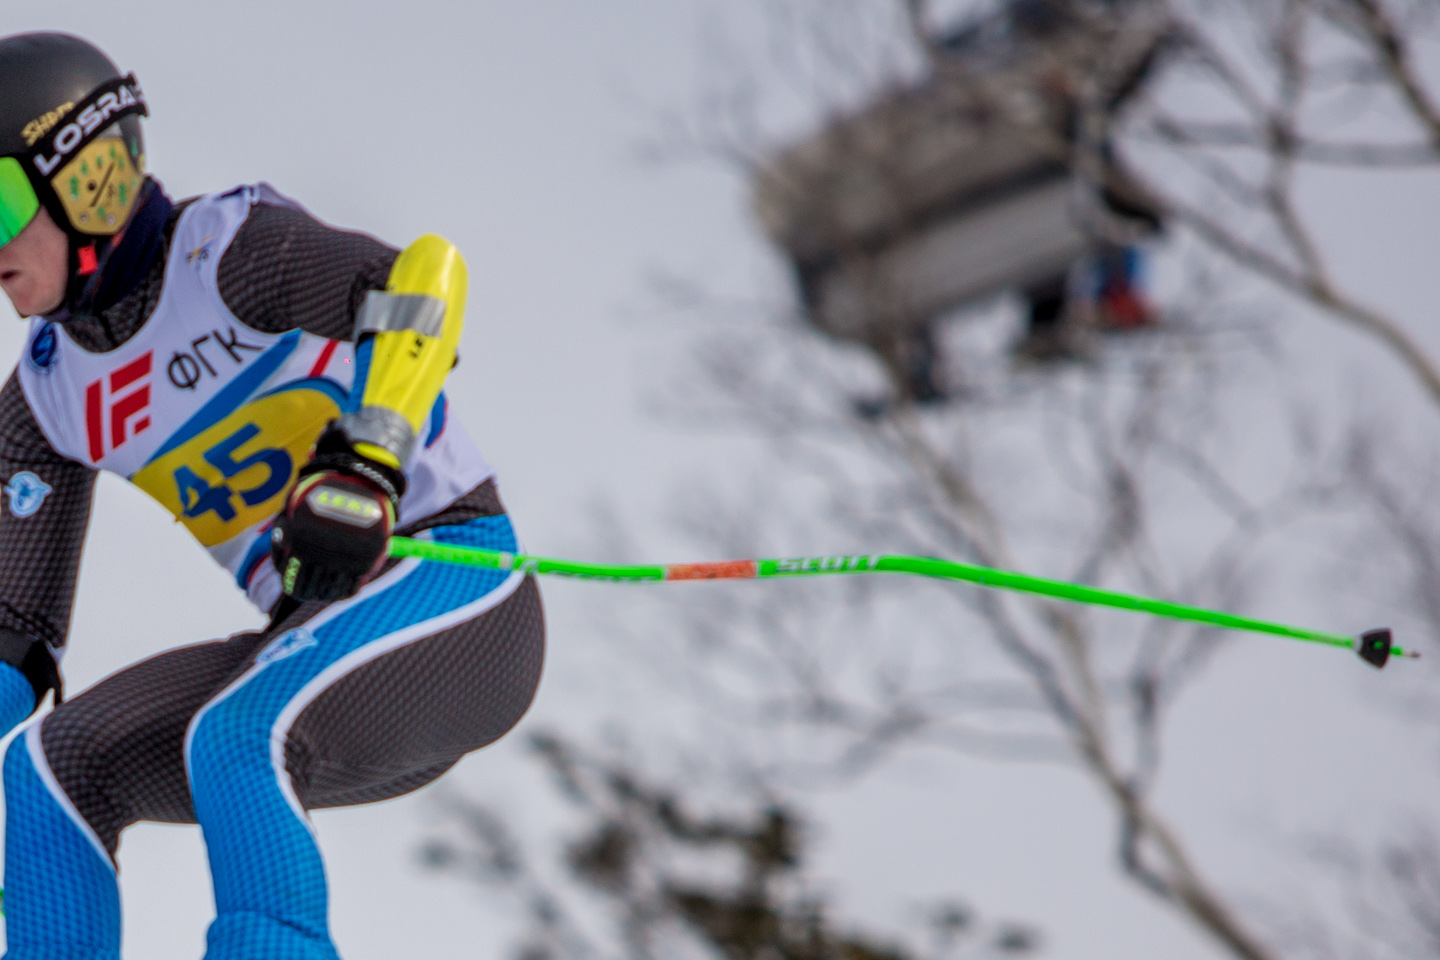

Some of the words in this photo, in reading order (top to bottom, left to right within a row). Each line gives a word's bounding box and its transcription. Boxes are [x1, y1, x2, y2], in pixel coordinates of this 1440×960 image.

[167, 326, 266, 391] ФГК
[173, 421, 293, 524] 45
[776, 553, 883, 572] SCOTT
